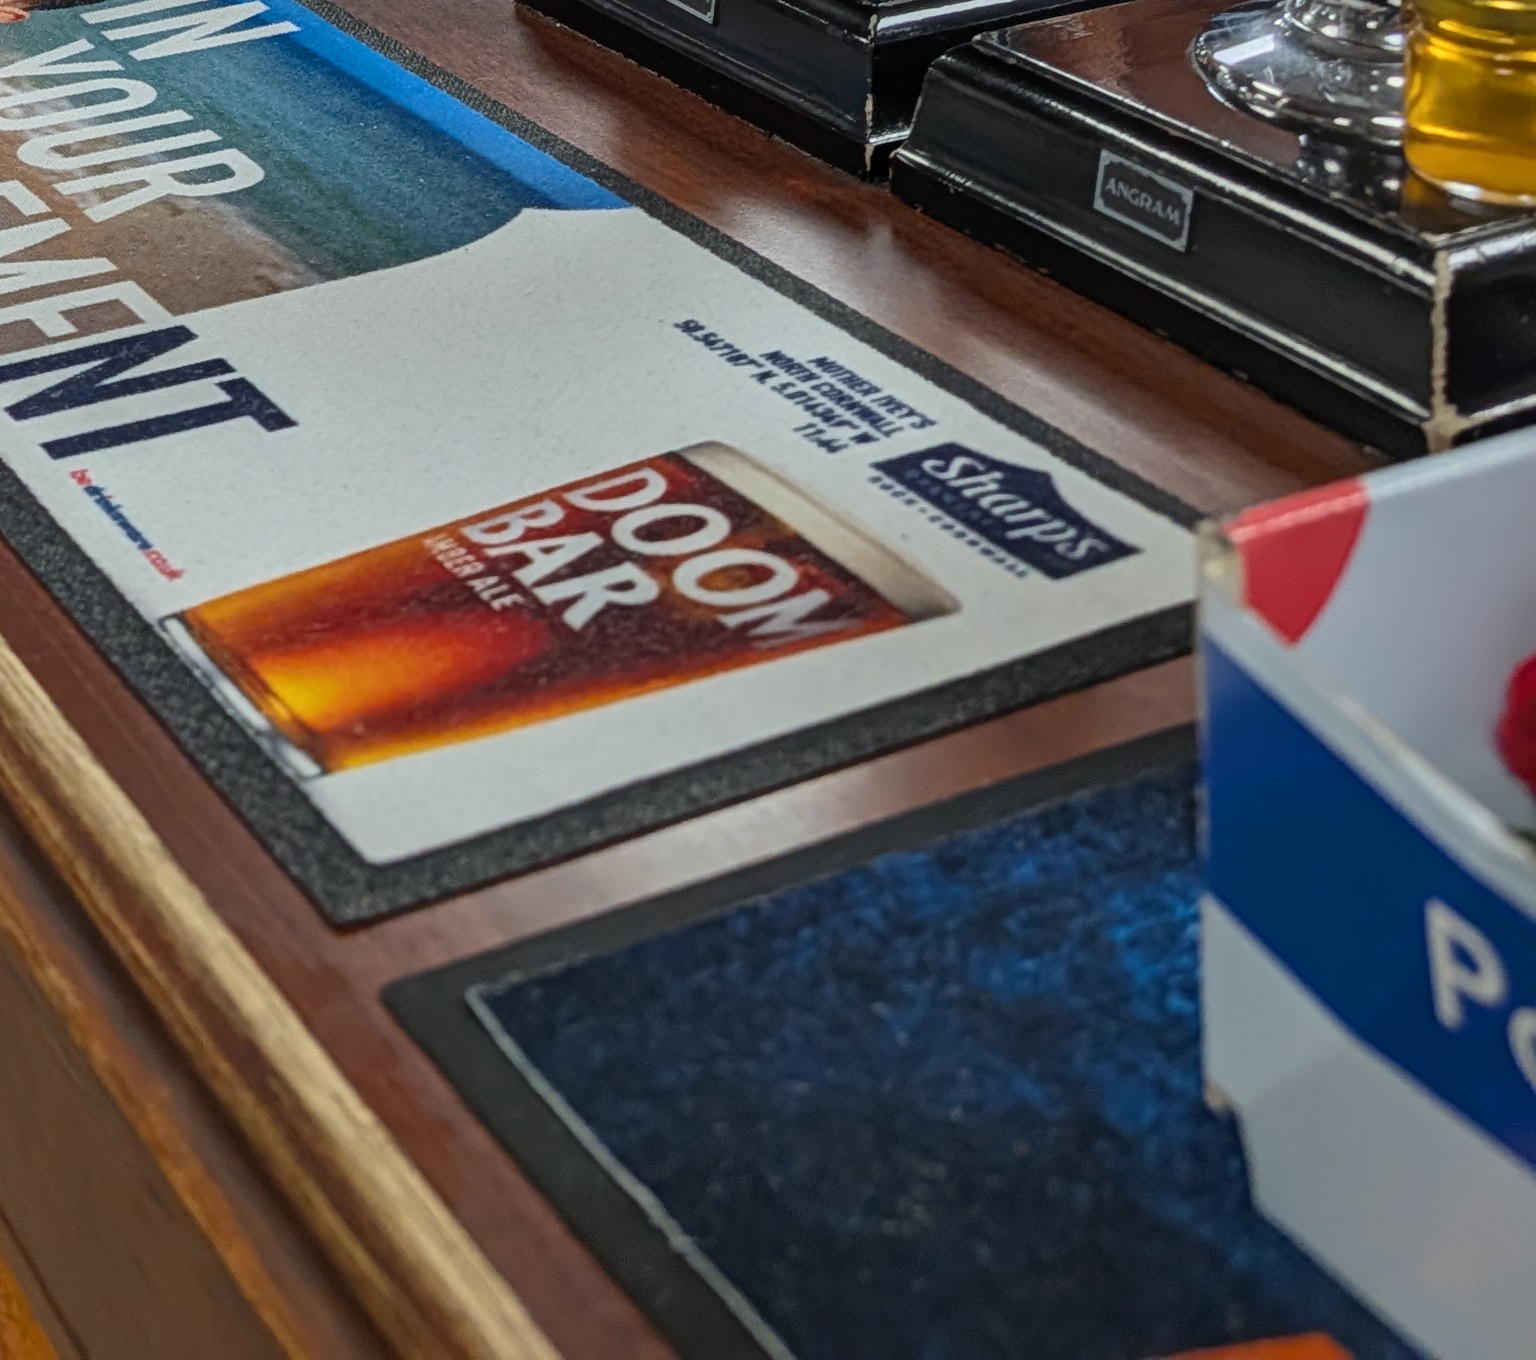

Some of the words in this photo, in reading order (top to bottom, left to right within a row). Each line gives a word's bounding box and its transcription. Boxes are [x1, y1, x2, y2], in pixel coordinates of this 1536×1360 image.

[1104, 177, 1181, 226] ANGRAM
[758, 348, 822, 383] NORTH
[810, 381, 904, 438] CORNWALL
[807, 355, 883, 397] MOTHER
[423, 531, 485, 579] AMBER
[465, 572, 527, 613] ALE
[459, 498, 661, 632] BAR
[565, 466, 863, 652] DOOM
